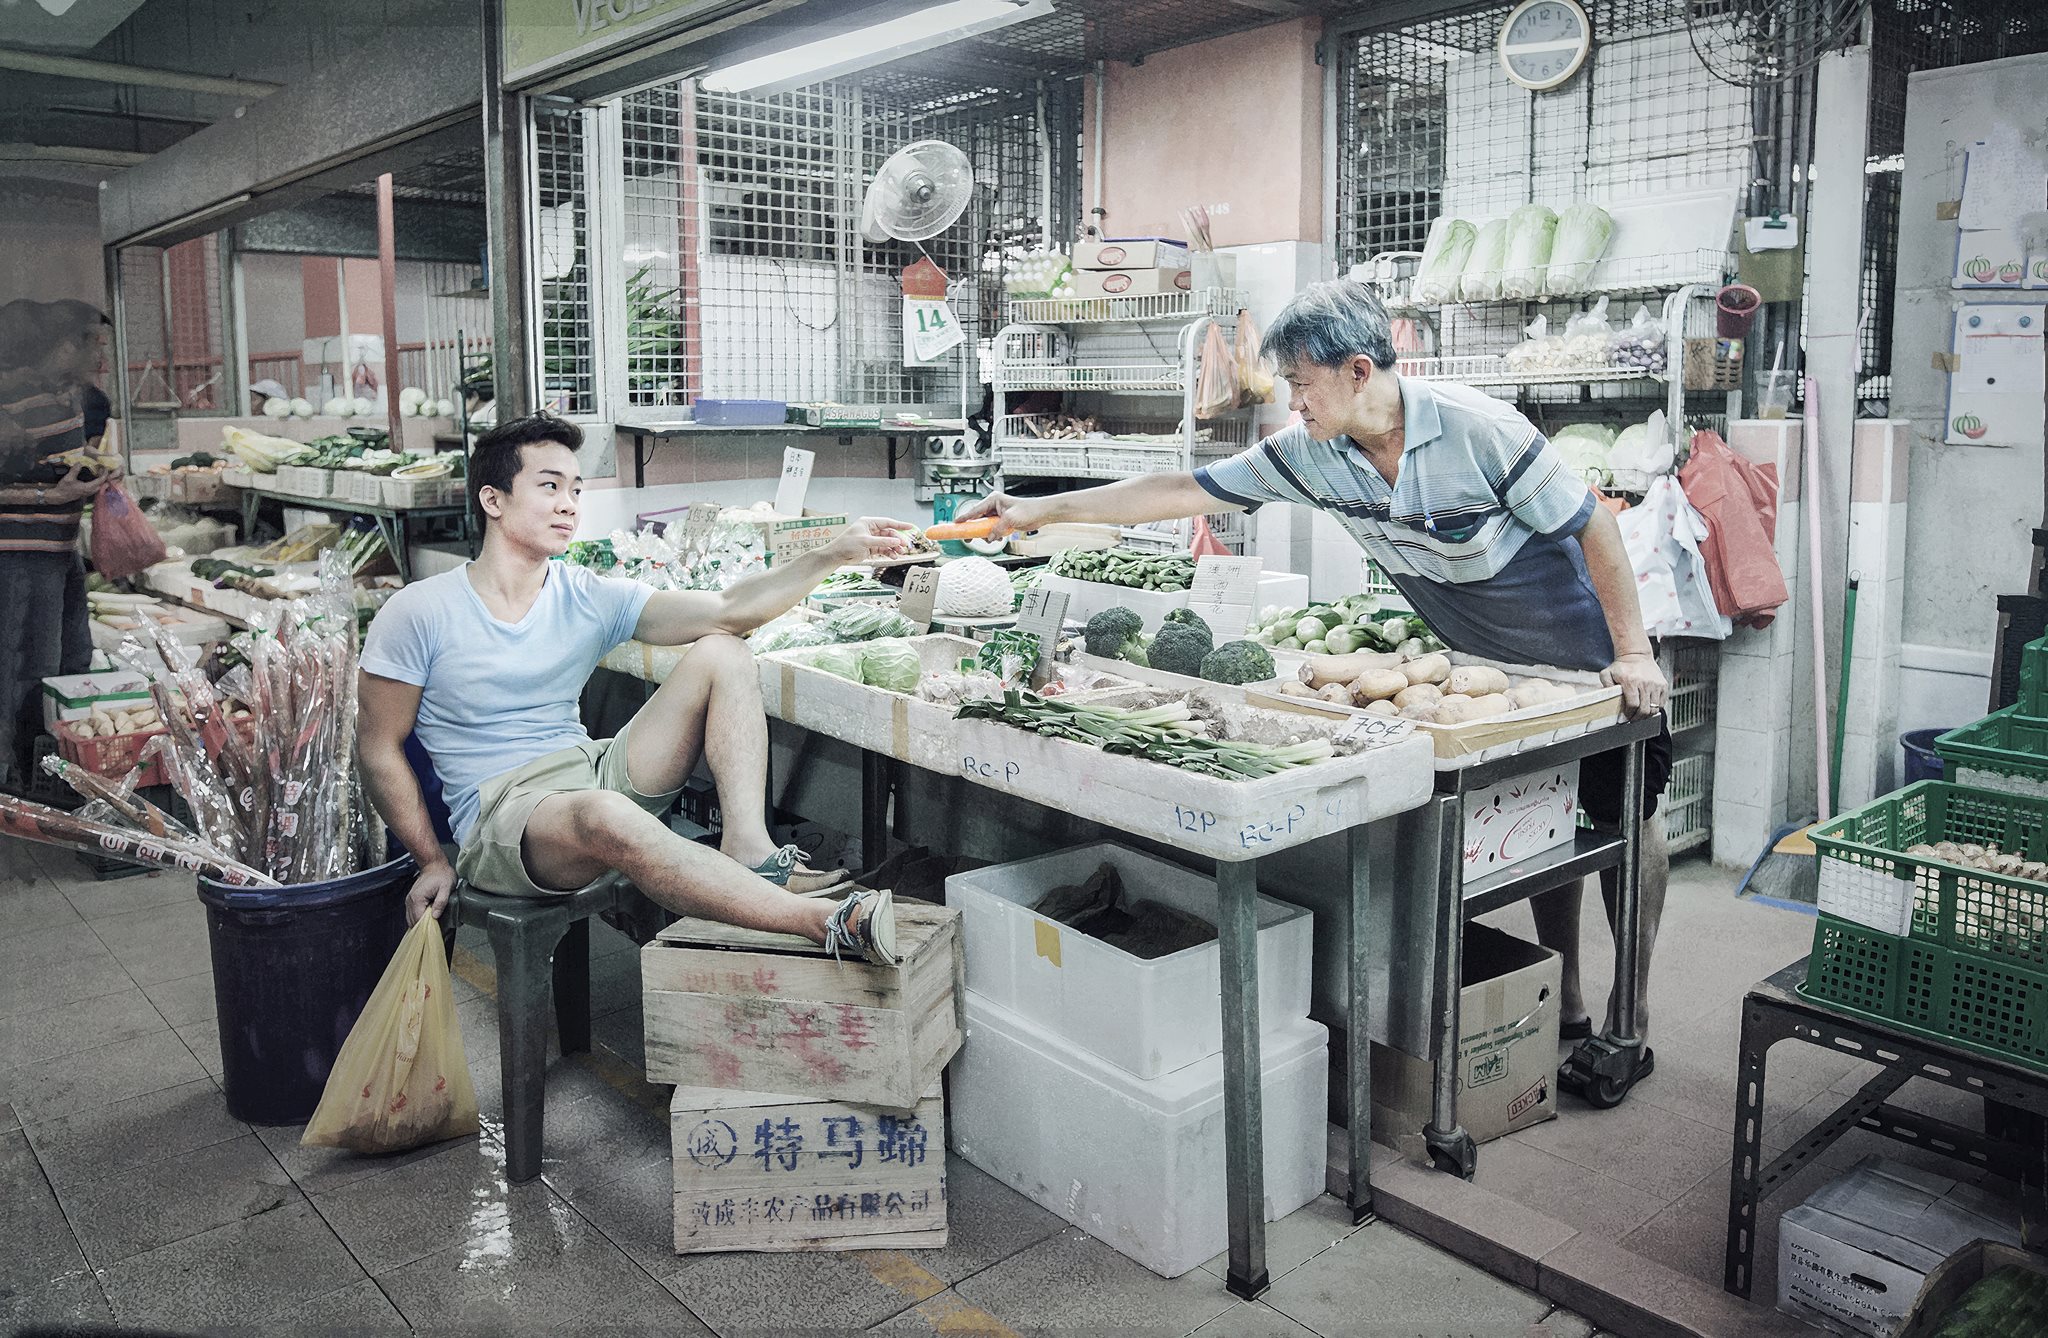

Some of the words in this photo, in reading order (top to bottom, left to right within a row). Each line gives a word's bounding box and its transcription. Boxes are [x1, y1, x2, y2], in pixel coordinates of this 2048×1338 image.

[1540, 9, 1550, 20] 12
[1566, 18, 1573, 29] 2
[1542, 65, 1549, 76] 6
[915, 308, 947, 333] 14
[823, 408, 880, 420] ASPARAGUS
[1025, 589, 1051, 617] $1
[1175, 805, 1216, 833] 12P
[1474, 1054, 1504, 1080] FAM
